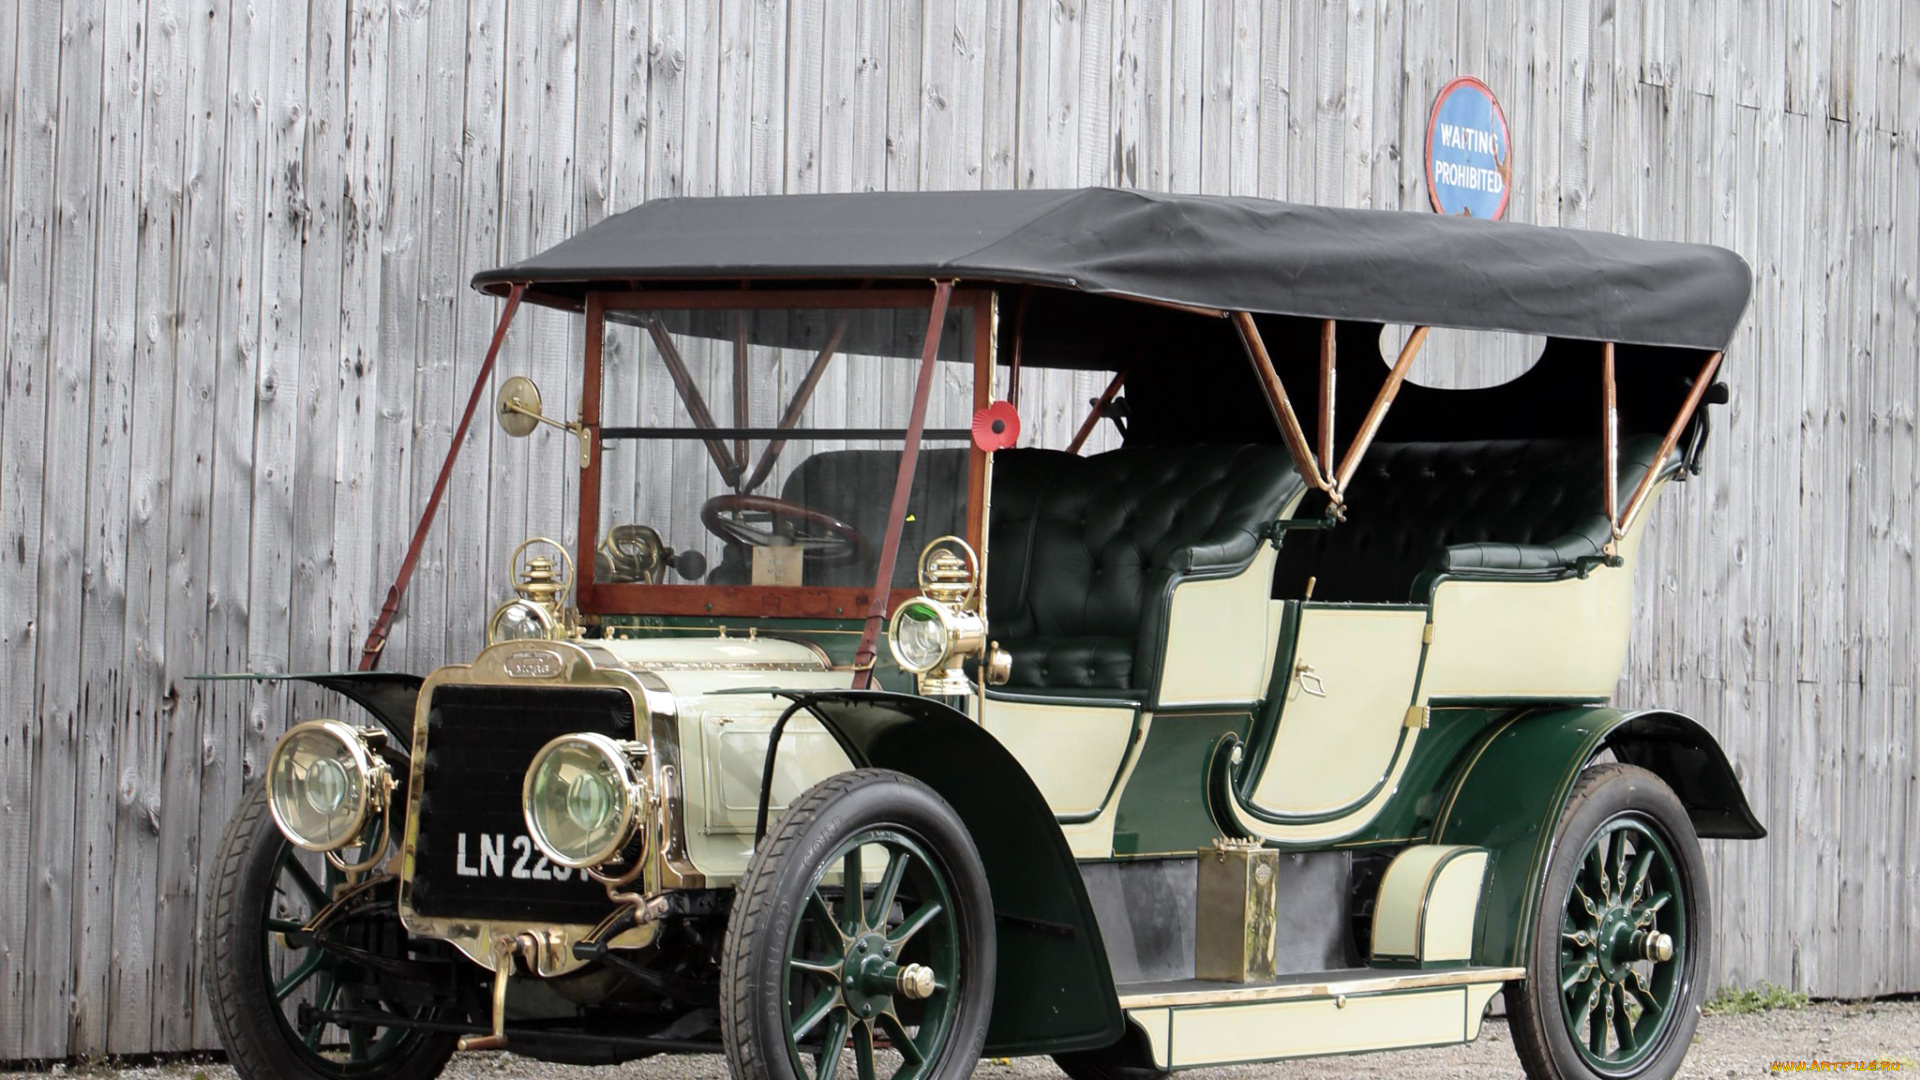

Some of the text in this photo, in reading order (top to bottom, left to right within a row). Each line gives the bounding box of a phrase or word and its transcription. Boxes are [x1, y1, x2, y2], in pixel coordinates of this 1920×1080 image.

[1440, 123, 1498, 154] WAITING
[1434, 160, 1503, 194] PROHIBITED
[456, 832, 589, 882] LN 22
